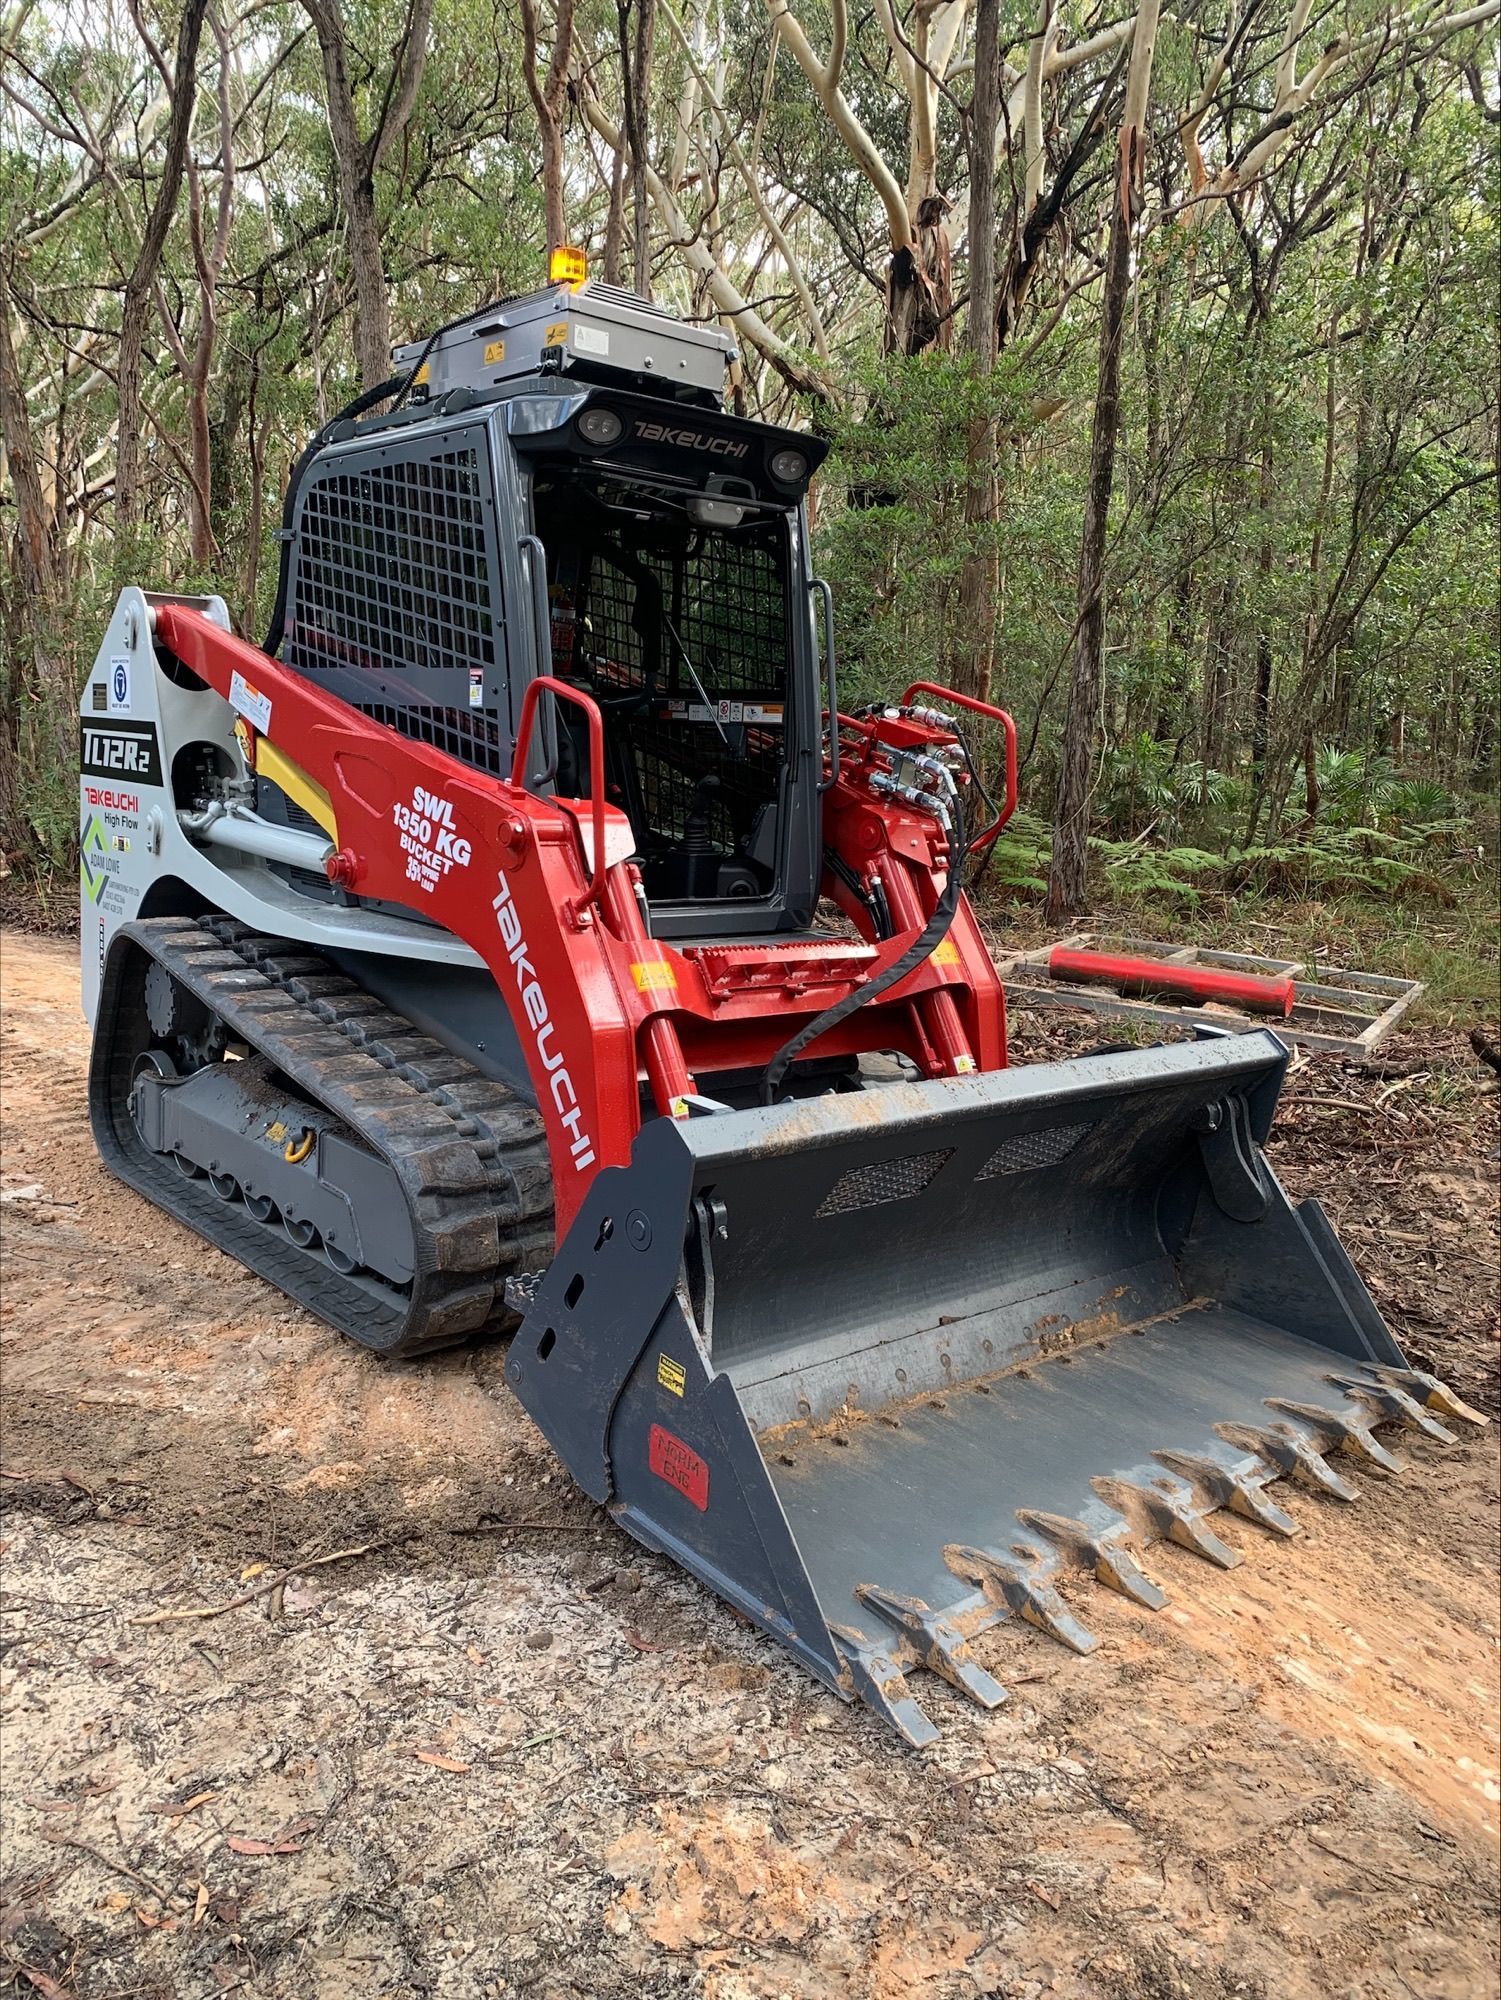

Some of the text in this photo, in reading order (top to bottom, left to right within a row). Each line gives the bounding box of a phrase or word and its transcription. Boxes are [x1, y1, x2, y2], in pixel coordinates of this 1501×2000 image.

[104, 812, 139, 830] High Flow
[412, 785, 457, 831] SWL
[393, 802, 472, 867] 1350 KG
[90, 853, 120, 874] ADAM LOWE
[400, 832, 454, 875] BUCKET
[663, 1460, 691, 1489] ENG
